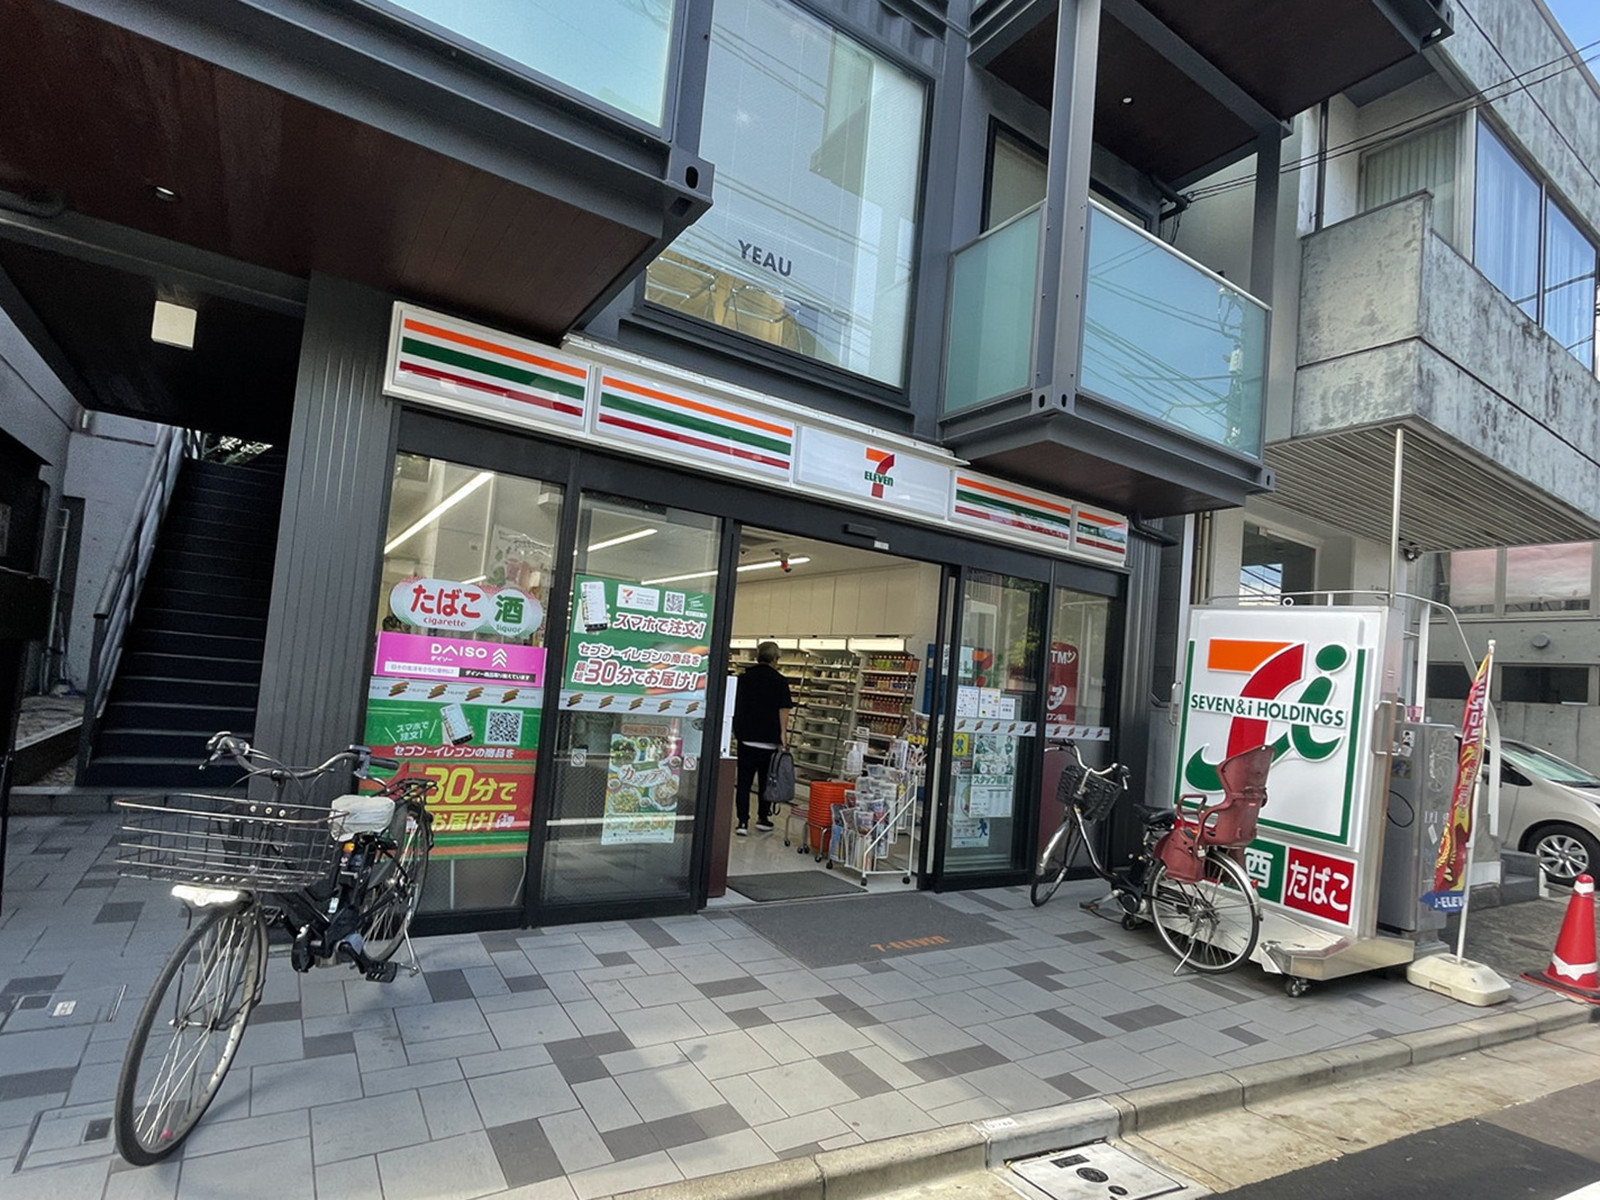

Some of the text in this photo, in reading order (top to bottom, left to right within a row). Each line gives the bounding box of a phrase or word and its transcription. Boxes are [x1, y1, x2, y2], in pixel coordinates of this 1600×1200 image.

[738, 239, 792, 277] YEAU
[410, 584, 481, 619] たばこ
[494, 594, 524, 624] 酒
[423, 616, 466, 627] cigarette
[430, 643, 487, 659] DAISO
[396, 720, 429, 733] スマホで
[1257, 701, 1344, 727] HOLDINGS
[400, 728, 424, 742] 注文!
[1287, 859, 1350, 912] たばこ
